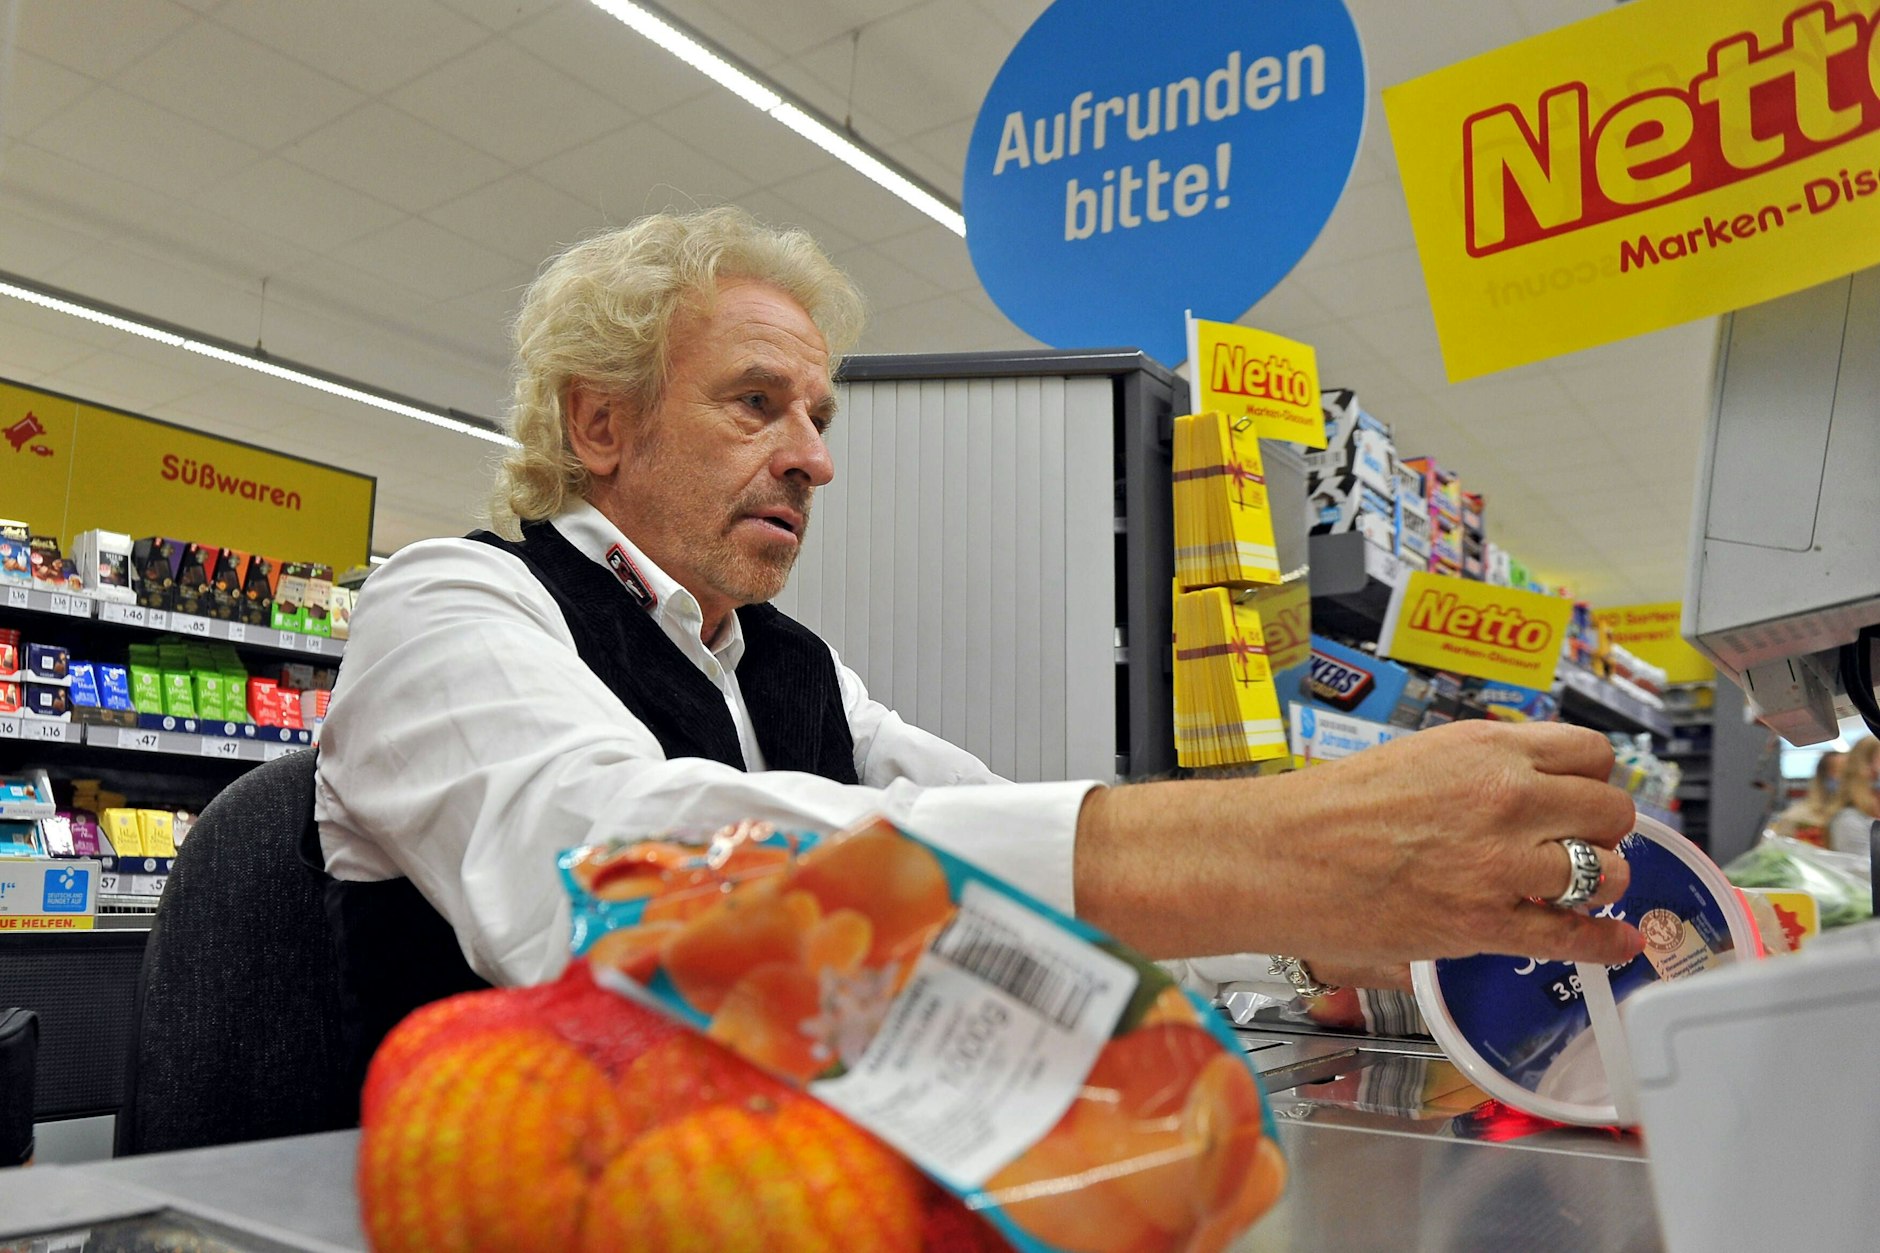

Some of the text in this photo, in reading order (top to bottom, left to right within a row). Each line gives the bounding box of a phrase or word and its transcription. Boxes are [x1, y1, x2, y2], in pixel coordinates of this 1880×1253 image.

[993, 44, 1326, 176] Aufrunden
[1064, 142, 1232, 242] bitte!
[1620, 168, 1880, 273] Marken-Dis
[1211, 343, 1312, 407] Netto
[160, 454, 302, 511] Süßwaren
[123, 608, 143, 620] 1.46
[1408, 589, 1553, 653] Netto
[42, 726, 61, 737] 1.16
[22, 918, 76, 928] HELFEN.
